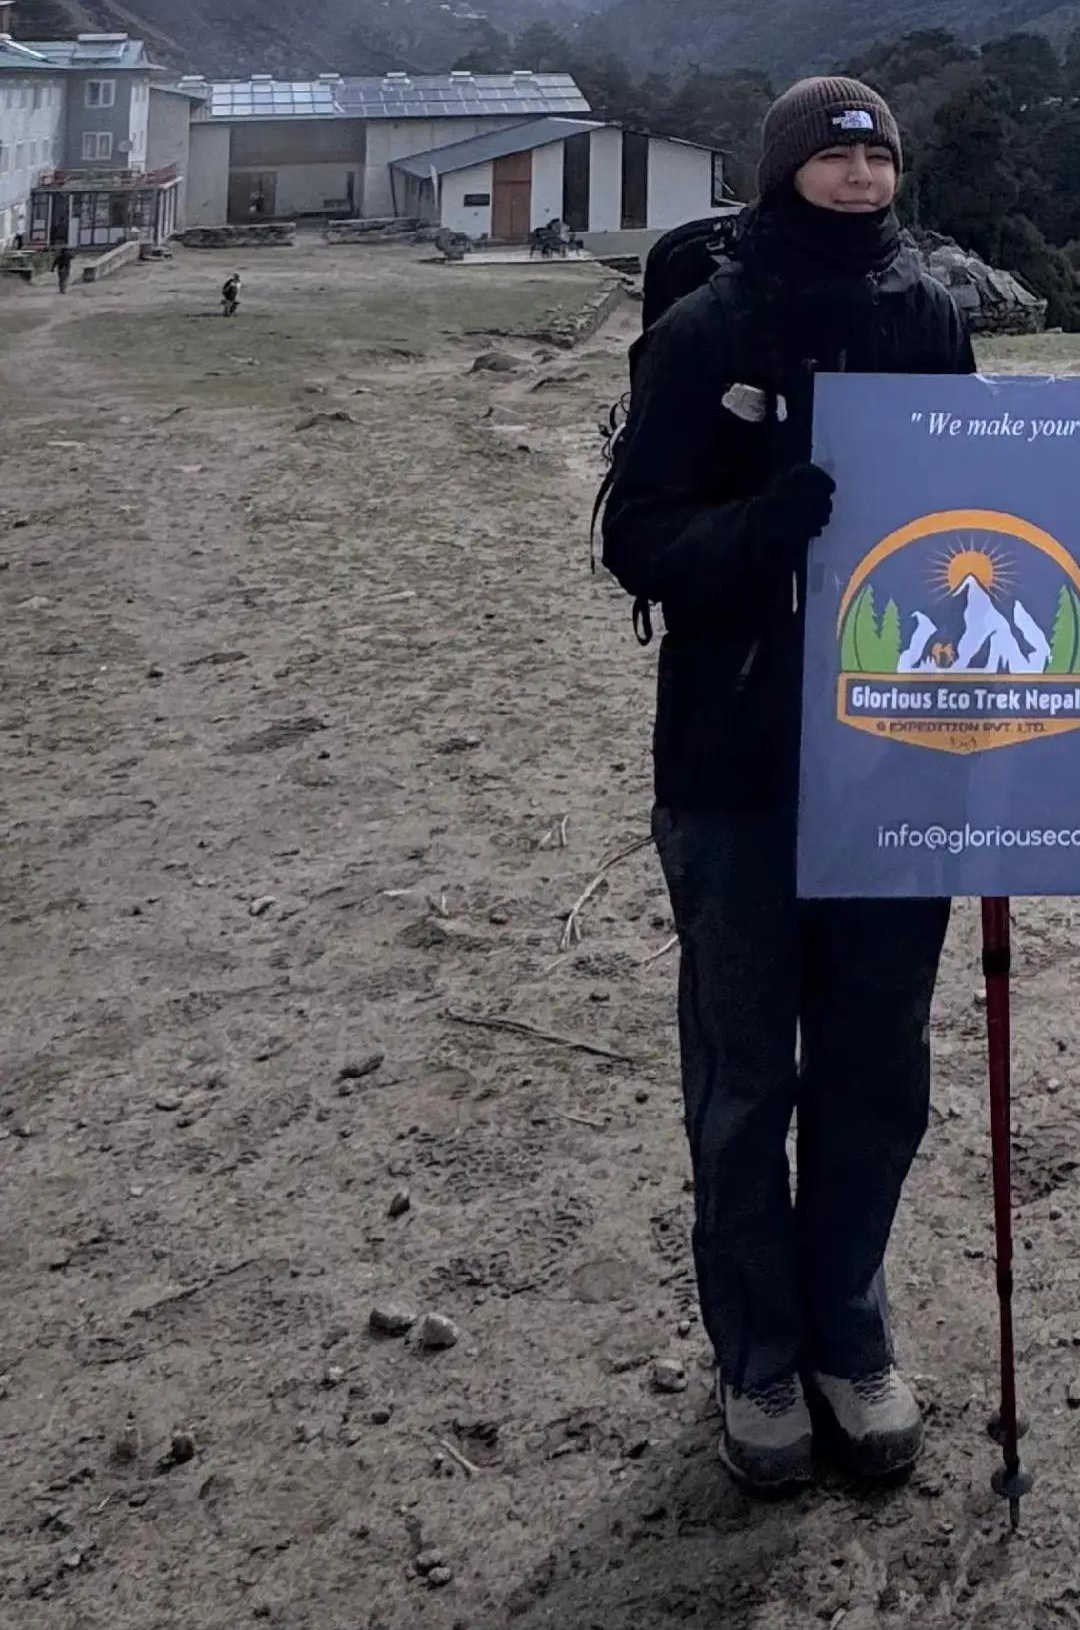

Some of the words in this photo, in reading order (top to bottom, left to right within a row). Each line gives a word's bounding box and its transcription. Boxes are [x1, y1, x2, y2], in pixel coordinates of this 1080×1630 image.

[928, 412, 962, 436] We
[967, 412, 1025, 437] make
[1026, 419, 1080, 443] your
[852, 685, 933, 711] Glorious
[937, 688, 970, 711] Eco
[974, 689, 1021, 711] Trek
[1025, 688, 1080, 715] Nepal
[890, 722, 979, 732] EXPEDITION
